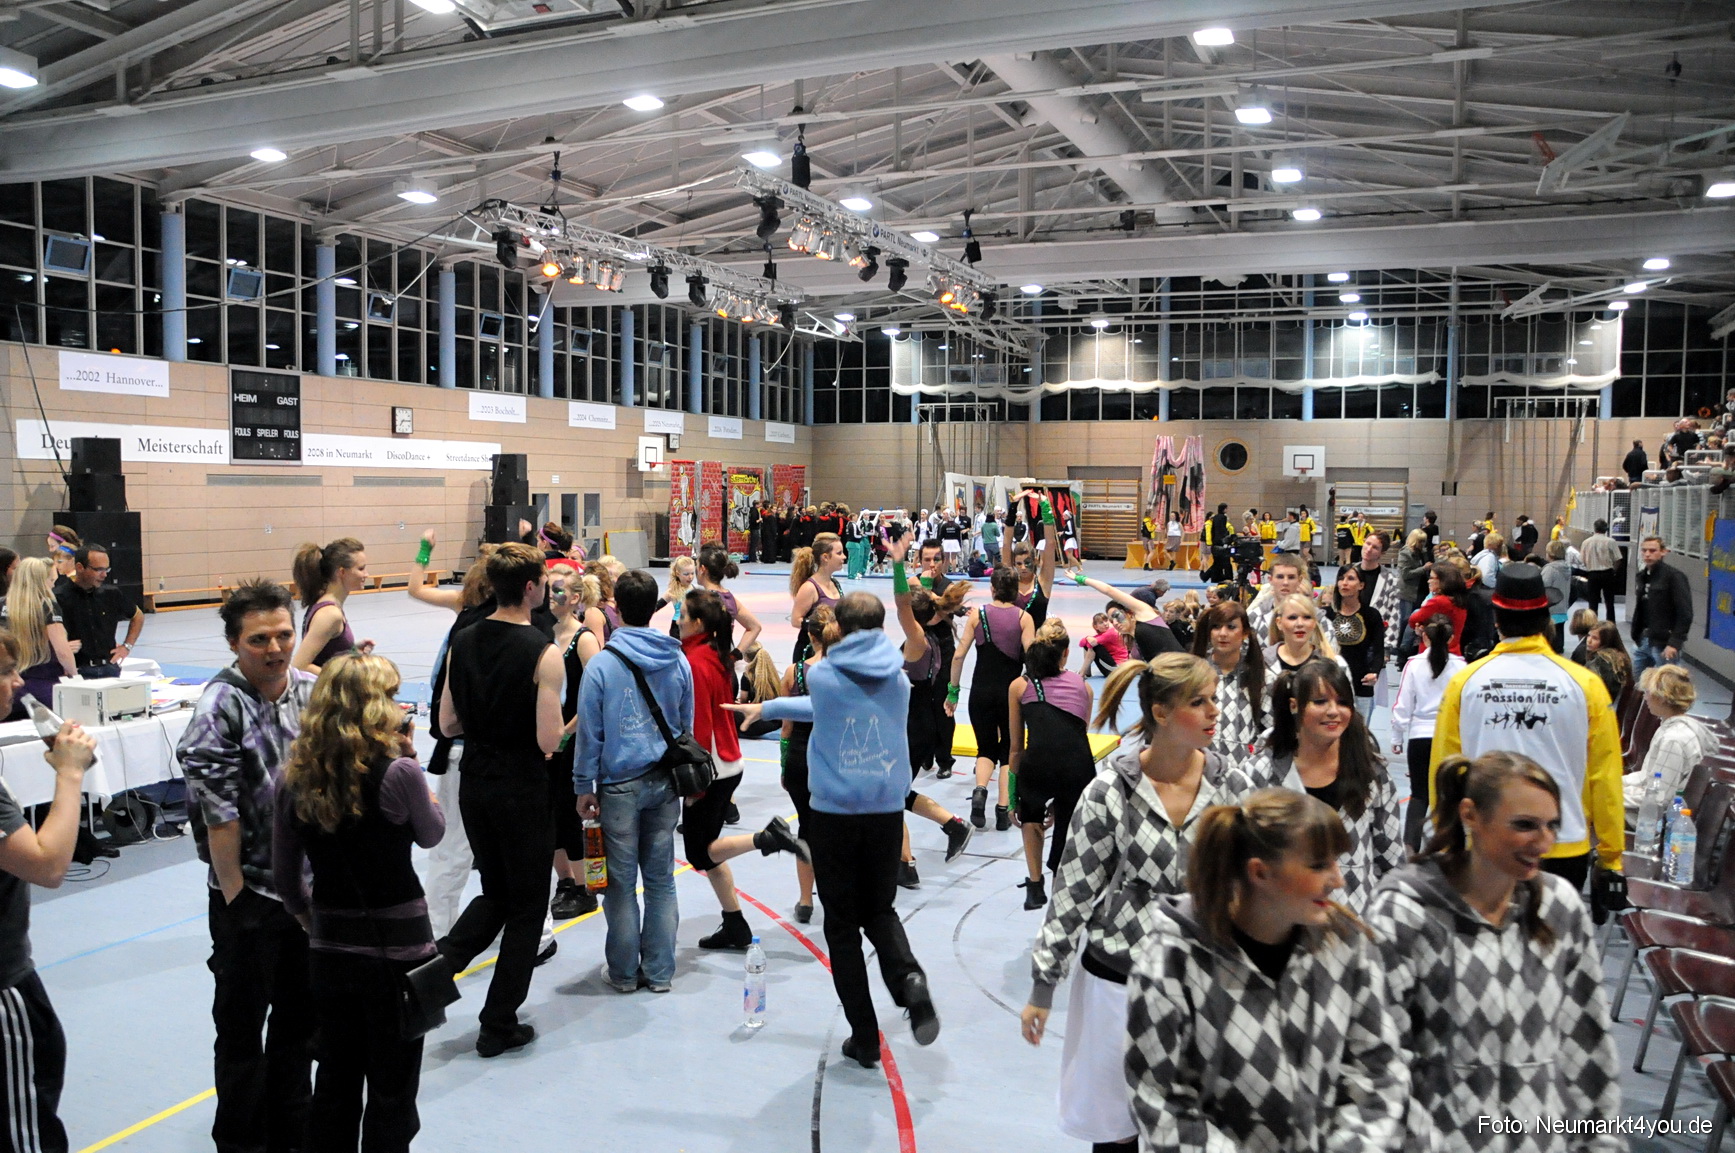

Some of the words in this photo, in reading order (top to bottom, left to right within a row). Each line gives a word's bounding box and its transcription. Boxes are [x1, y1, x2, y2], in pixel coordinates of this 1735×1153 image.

[880, 228, 896, 244] PARTL
[234, 393, 257, 403] HEIM
[277, 396, 298, 406] GAST
[235, 427, 251, 437] FOULS
[256, 428, 279, 438] SPIELER
[283, 429, 299, 439] FOULS
[138, 437, 224, 455] Meisterschaft
[326, 448, 334, 458] in
[336, 449, 373, 460] Neumarkt
[386, 450, 425, 461] DiscoDance
